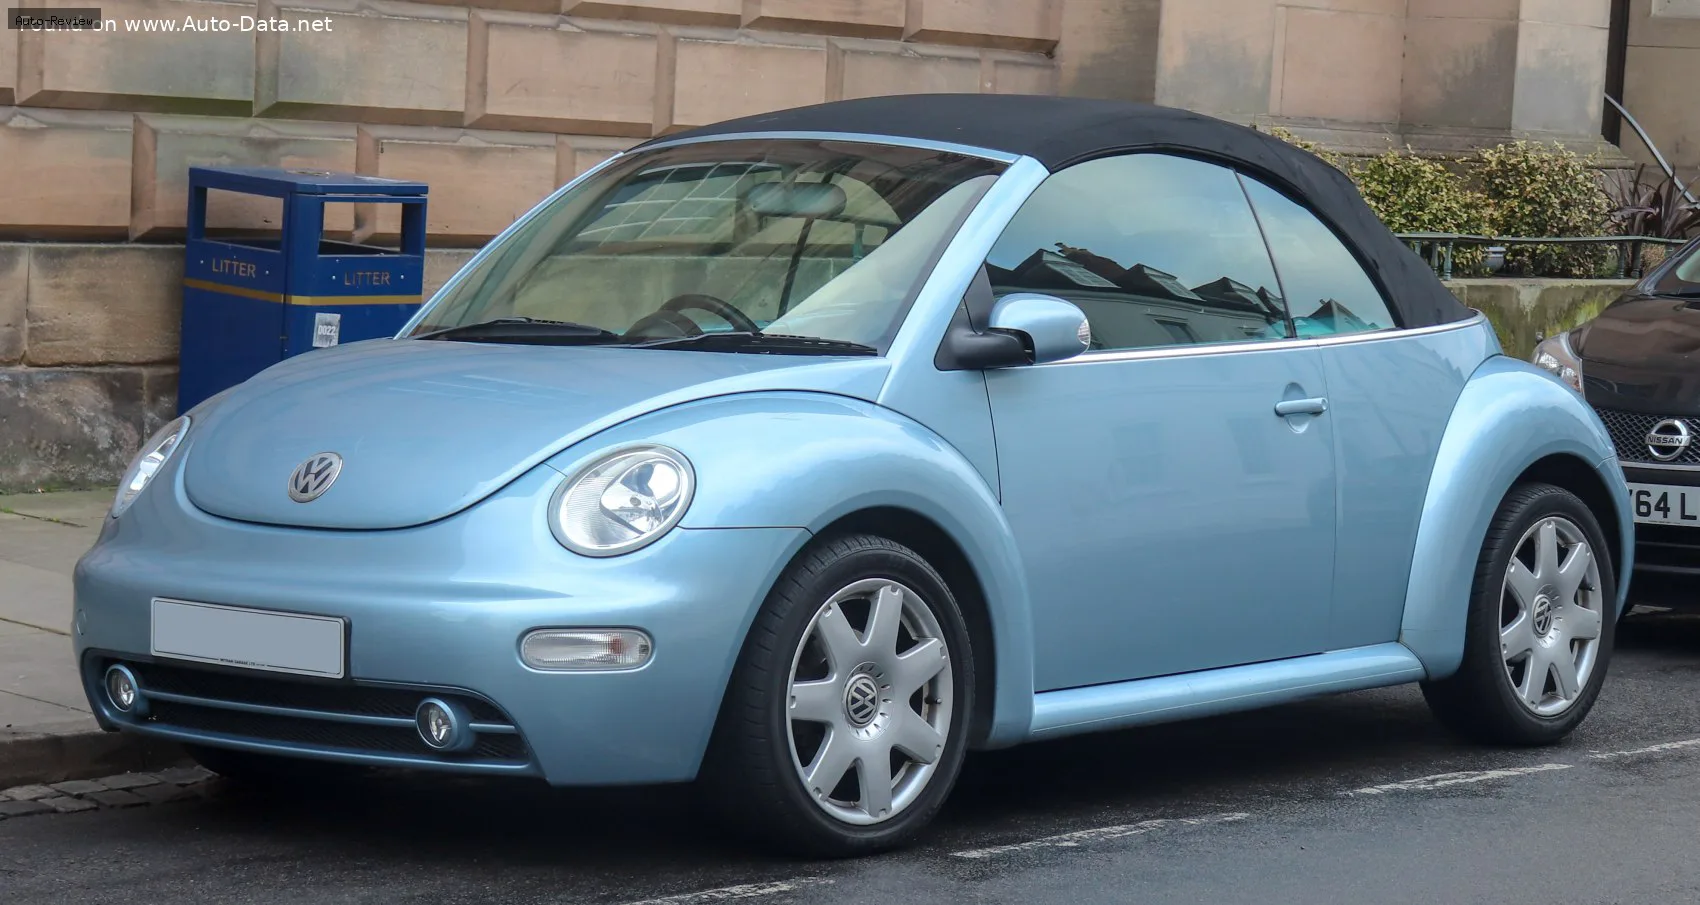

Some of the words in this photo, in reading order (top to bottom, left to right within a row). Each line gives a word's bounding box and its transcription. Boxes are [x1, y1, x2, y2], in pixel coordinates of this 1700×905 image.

[212, 257, 256, 279] LITTER
[344, 271, 391, 286] LITTER
[1647, 435, 1683, 445] NISSAN
[1629, 489, 1671, 519] 64
